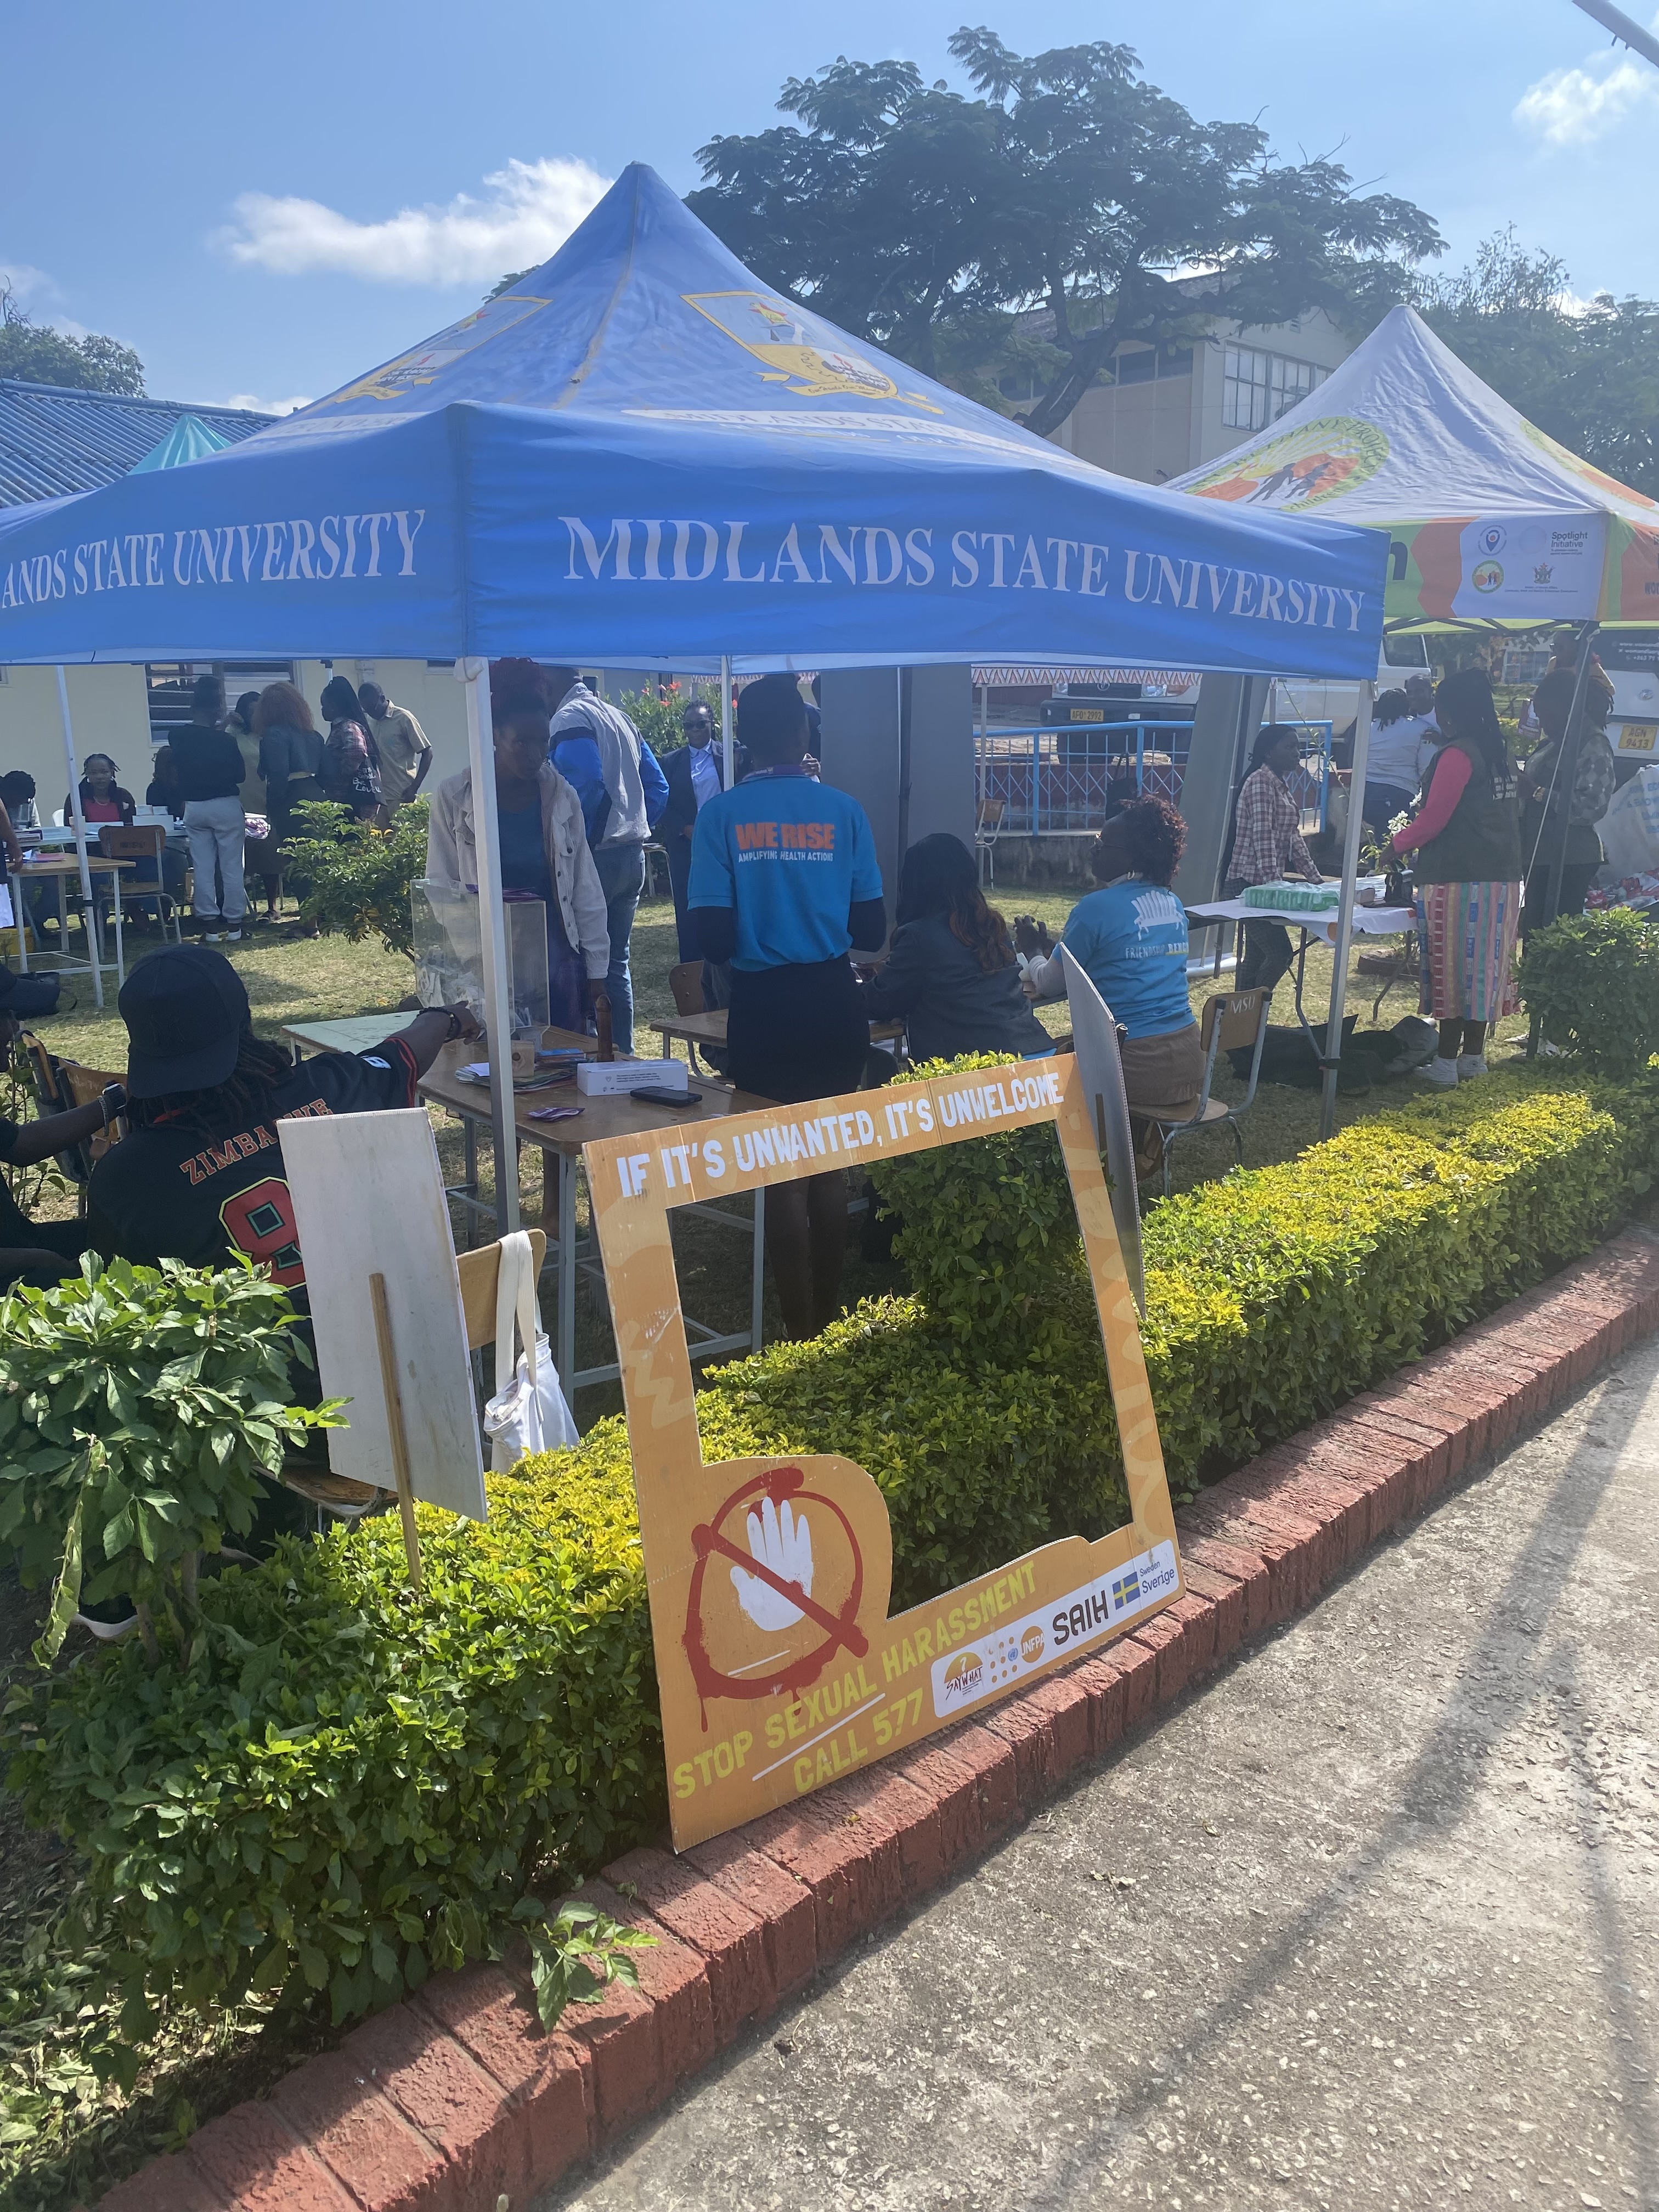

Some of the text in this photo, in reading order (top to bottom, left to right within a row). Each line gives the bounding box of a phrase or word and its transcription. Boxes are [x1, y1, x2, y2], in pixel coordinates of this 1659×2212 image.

[1551, 531, 1588, 541] Spotlight
[2, 509, 426, 609] ANDS STATE UNIVERSITY
[558, 516, 1365, 632] MIDLANDS STATE UNIVERSITY
[735, 822, 834, 850] WE RISE
[738, 850, 833, 863] AMPLIFYING HEALTH ACTIONS
[1230, 995, 1255, 1014] MSU
[617, 1072, 1064, 1198] IF IT'S UNWANTED, IT'S UNWELCOME
[1139, 1561, 1160, 1577] Sweden
[1142, 1568, 1175, 1594] Sverige
[1053, 1590, 1109, 1645] SAIH
[1020, 1632, 1045, 1656] UNFPA
[673, 1560, 1039, 1799] STOP SEXUAL HARASSMENT
[793, 1688, 923, 1793] CALL 577
